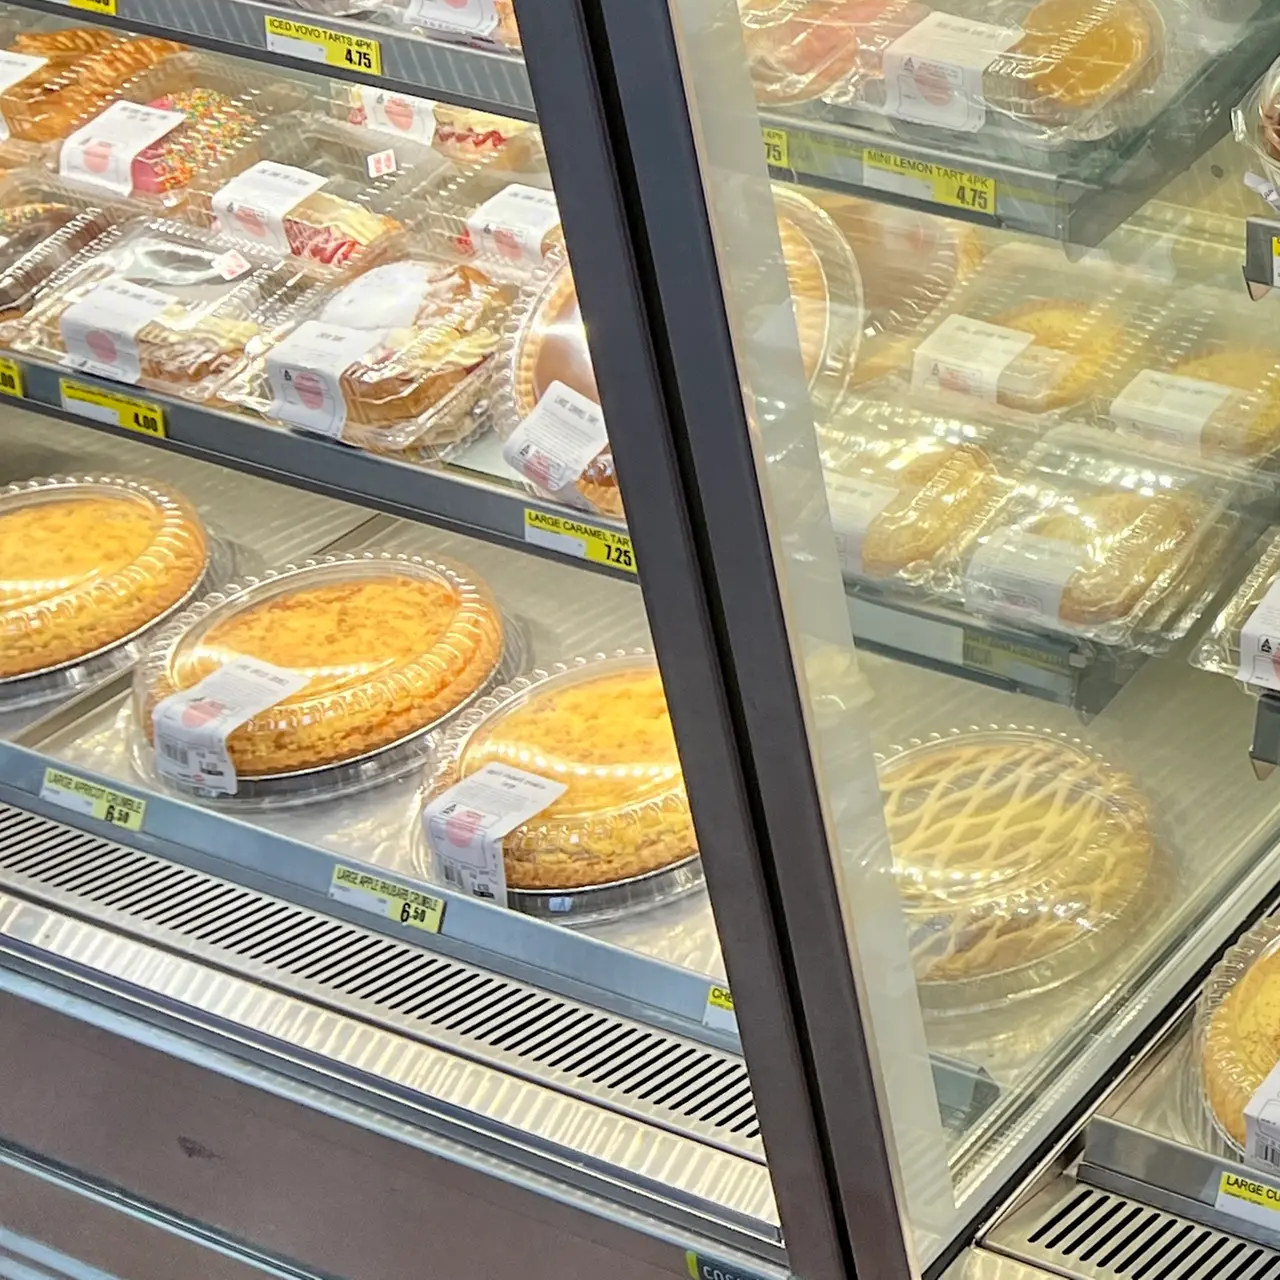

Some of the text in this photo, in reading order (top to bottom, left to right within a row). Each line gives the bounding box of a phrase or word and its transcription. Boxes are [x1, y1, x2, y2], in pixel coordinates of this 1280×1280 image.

[269, 19, 291, 32] ICED
[294, 23, 321, 38] VOVO
[322, 30, 353, 46] TARTS
[345, 48, 372, 68] 4.75
[763, 142, 782, 162] 75
[868, 150, 989, 189] MINI LEMON TART 4PK
[956, 186, 988, 210] 4.75
[528, 512, 631, 546] LARGE CARAMEL TAR
[604, 545, 632, 567] 7.25
[48, 771, 72, 789] LARGE
[105, 805, 130, 824] 6.50
[337, 867, 358, 885] LARGE
[359, 875, 379, 891] APPLE
[409, 891, 438, 911] CRUMBLE
[400, 902, 427, 923] 6.50
[712, 988, 732, 1003] CHE
[1226, 1175, 1263, 1195] LARGE
